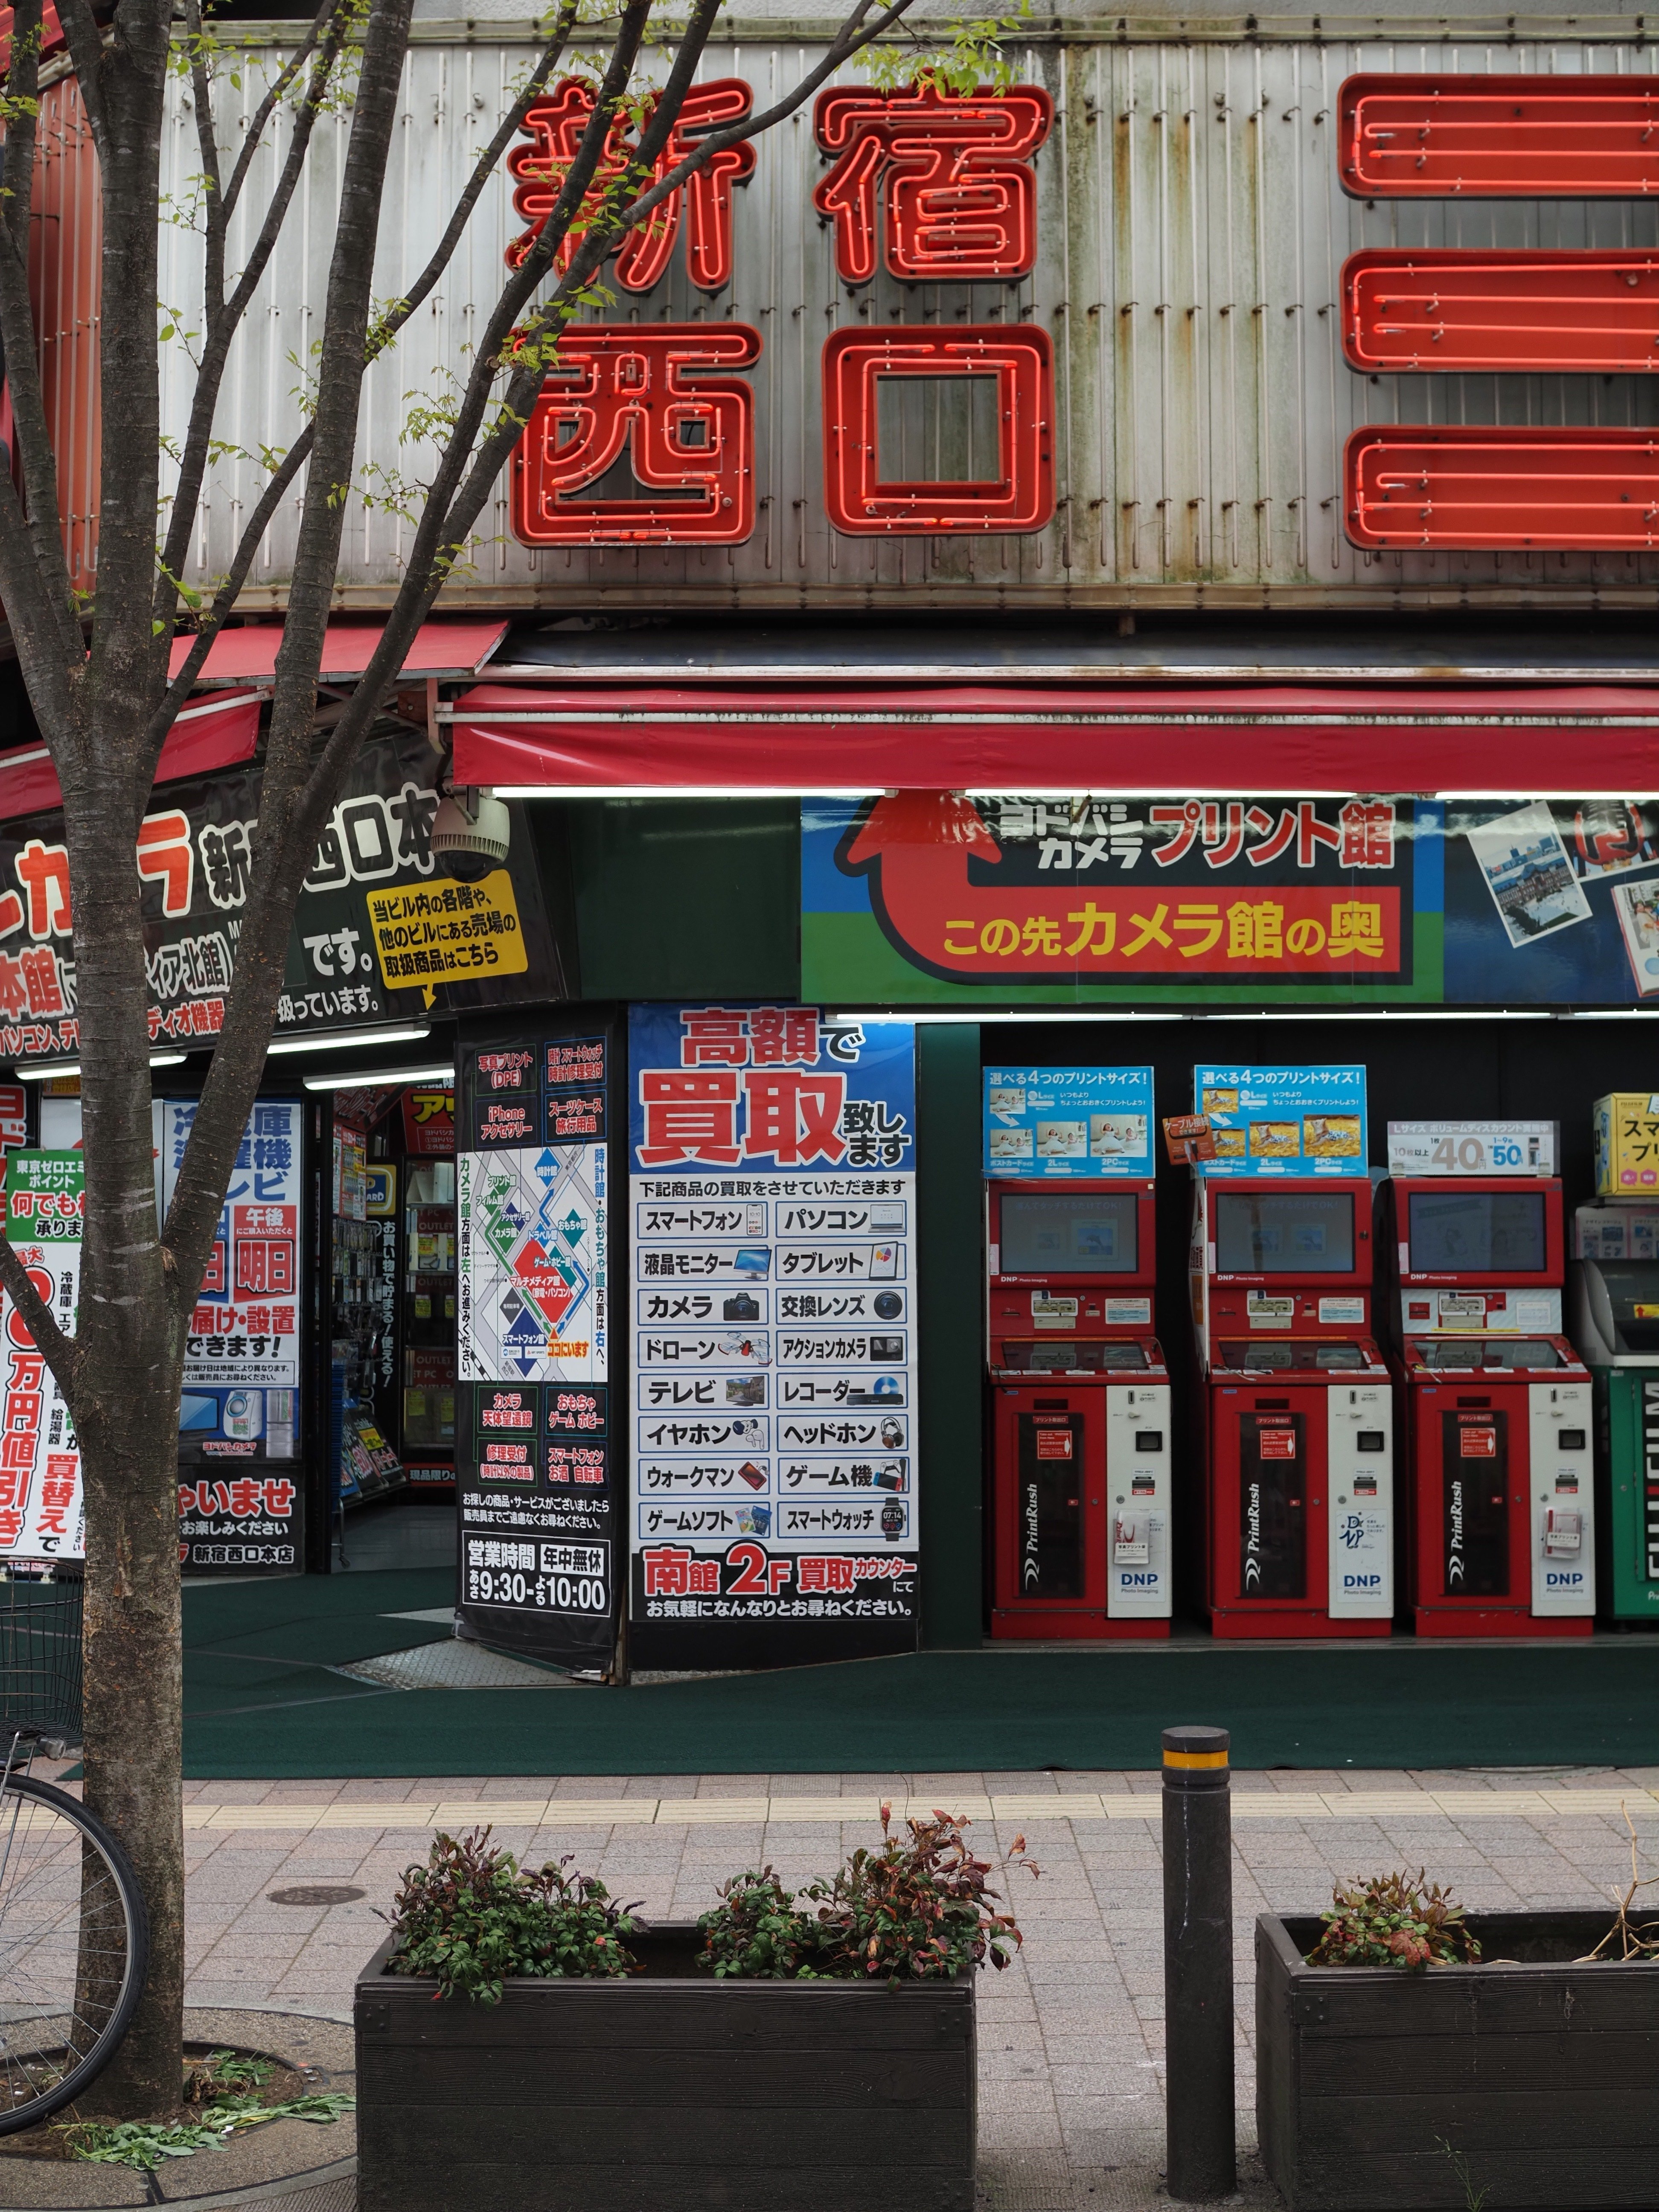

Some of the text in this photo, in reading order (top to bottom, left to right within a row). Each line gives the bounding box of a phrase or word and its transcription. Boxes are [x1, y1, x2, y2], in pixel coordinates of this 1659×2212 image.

[506, 67, 1055, 294] 新宿
[508, 321, 1056, 548] 西口
[1000, 804, 1144, 836] ヨドバシ
[1038, 800, 1396, 869] カメラ プリント館
[373, 884, 492, 923] 当ビル内の各階や、
[379, 911, 516, 950] 他のビルにある売場の
[944, 901, 1384, 958] この先カメラ館の奥
[384, 942, 499, 978] 取扱商品はこちら
[679, 1007, 866, 1067] 高額で
[478, 1052, 533, 1071] 写真プリント
[548, 1044, 602, 1065] 時計 スマートウォッチ
[491, 1070, 522, 1089] (DPE)
[548, 1062, 603, 1082] 時計修理受付
[989, 1070, 1148, 1086] 選べる4つのプリントサイズ!
[1202, 1069, 1360, 1085] 選べる4つのプリントサイズ!
[488, 1105, 525, 1122] iPhone
[548, 1097, 603, 1117] スーツケース
[480, 1121, 533, 1140] アクセサリー
[556, 1116, 597, 1134] 旅行用品
[1393, 1124, 1426, 1133] Lサイズ
[488, 1175, 517, 1187] プリント館
[536, 1165, 558, 1178] 時計館
[29, 1175, 75, 1189] ポイント
[639, 1181, 907, 1198] 下記商品の買取をさせていただきます
[476, 1195, 504, 1206] フィルム館
[245, 1208, 285, 1228] 午後
[558, 1218, 588, 1231] おもちゃ館
[645, 1210, 742, 1231] スマートフォン
[784, 1208, 869, 1231] パソコン
[236, 1228, 294, 1236] にご購入いただくと
[494, 1227, 518, 1238] カメラ館
[528, 1228, 559, 1241] トラベル館
[237, 1240, 294, 1293] 明日
[644, 1253, 733, 1276] 液晶モニター
[782, 1251, 864, 1274] タブレット
[510, 1275, 561, 1287] マルチメディア館
[647, 1295, 713, 1319] カメラ
[781, 1294, 866, 1318] 交換レンズ
[186, 1335, 281, 1358] できます!
[502, 1333, 545, 1345] スマートフォン館
[783, 1337, 867, 1359] アクションカメラ
[547, 1341, 589, 1358] ココにいます
[647, 1339, 716, 1361] ドローン
[493, 1393, 522, 1409] カメラ
[648, 1380, 716, 1405] テレビ
[785, 1380, 866, 1402] レコーダー
[557, 1394, 597, 1412] おもちゃ
[482, 1409, 533, 1428] 天体望遠鏡
[549, 1412, 605, 1429] ゲーム ホビー
[647, 1423, 732, 1445] イヤホン
[783, 1422, 876, 1444] ヘッドホン
[486, 1444, 527, 1463] 修理受付
[547, 1447, 605, 1465] スマートフォン
[480, 1463, 534, 1481] (時計以外の製品)
[549, 1465, 605, 1484] お酒 自転車
[647, 1465, 735, 1488] ウォークマン
[786, 1464, 873, 1488] ゲーム機
[462, 1493, 610, 1513] お探しの商品・サービスがございましたら
[463, 1509, 601, 1530] 販売員までご遠慮なくお尋ねください。
[647, 1510, 733, 1532] ゲームソフト
[787, 1508, 874, 1531] スマートウォッチ
[1026, 1483, 1038, 1553] PrintRush
[1247, 1483, 1260, 1553] PrintRush
[1450, 1481, 1463, 1550] PrintRush
[178, 1520, 289, 1536] お楽しみください
[193, 1543, 295, 1565] 新宿西口本店
[468, 1539, 602, 1573] 営業時間 年中無休
[643, 1548, 721, 1597] 南館
[725, 1542, 792, 1596] 2F
[1547, 1573, 1583, 1585] DNP
[1121, 1574, 1158, 1586] DNP
[1344, 1575, 1381, 1587] DNP
[647, 1599, 913, 1618] お気軽になんなりとお尋ねください。
